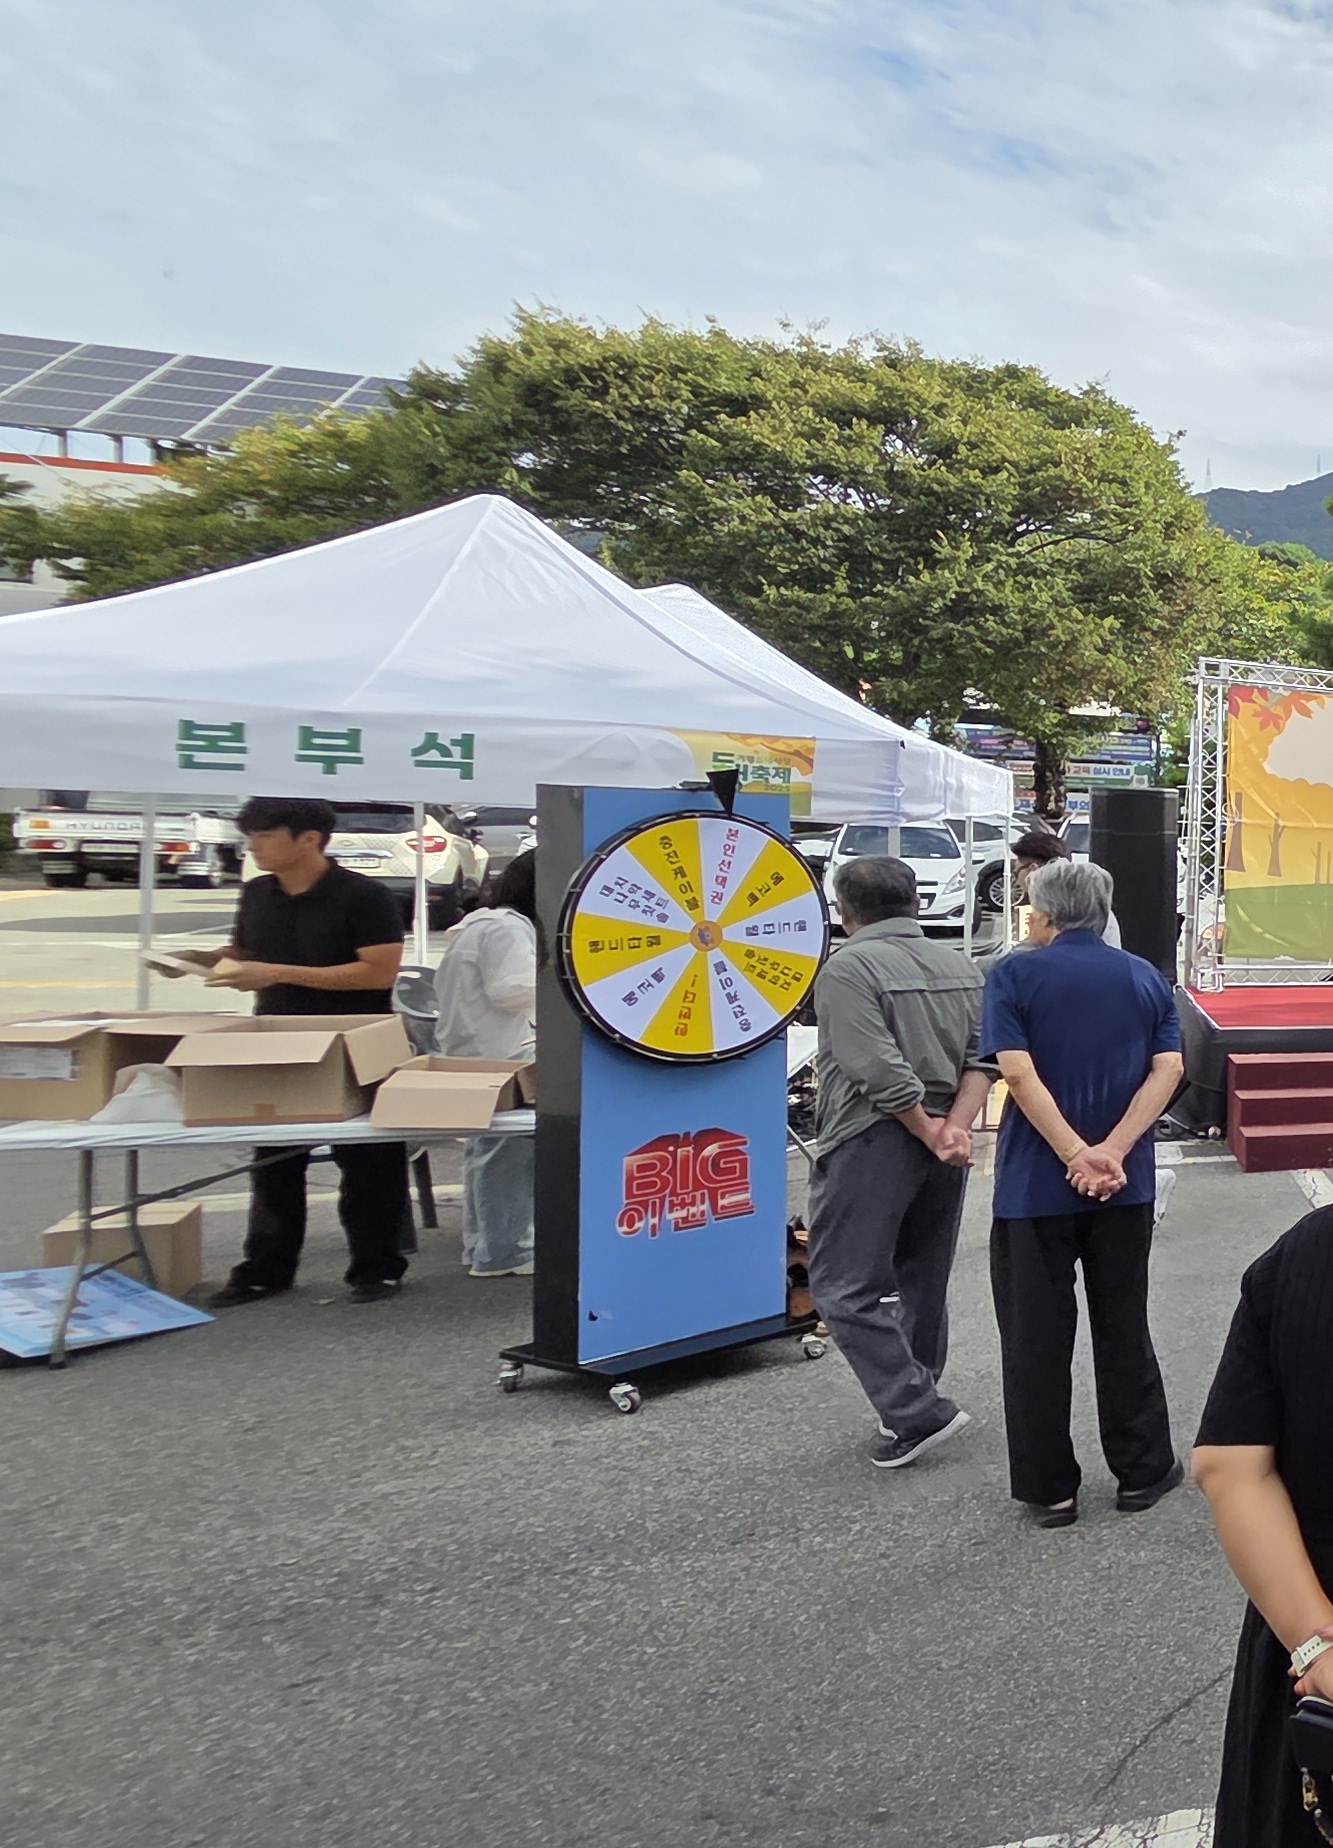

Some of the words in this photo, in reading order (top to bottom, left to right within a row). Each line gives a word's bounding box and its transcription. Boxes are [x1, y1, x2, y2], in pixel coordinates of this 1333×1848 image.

[66, 822, 141, 831] HYUNDA
[623, 1129, 750, 1202] BIG
[616, 1185, 755, 1239] 이벤트
